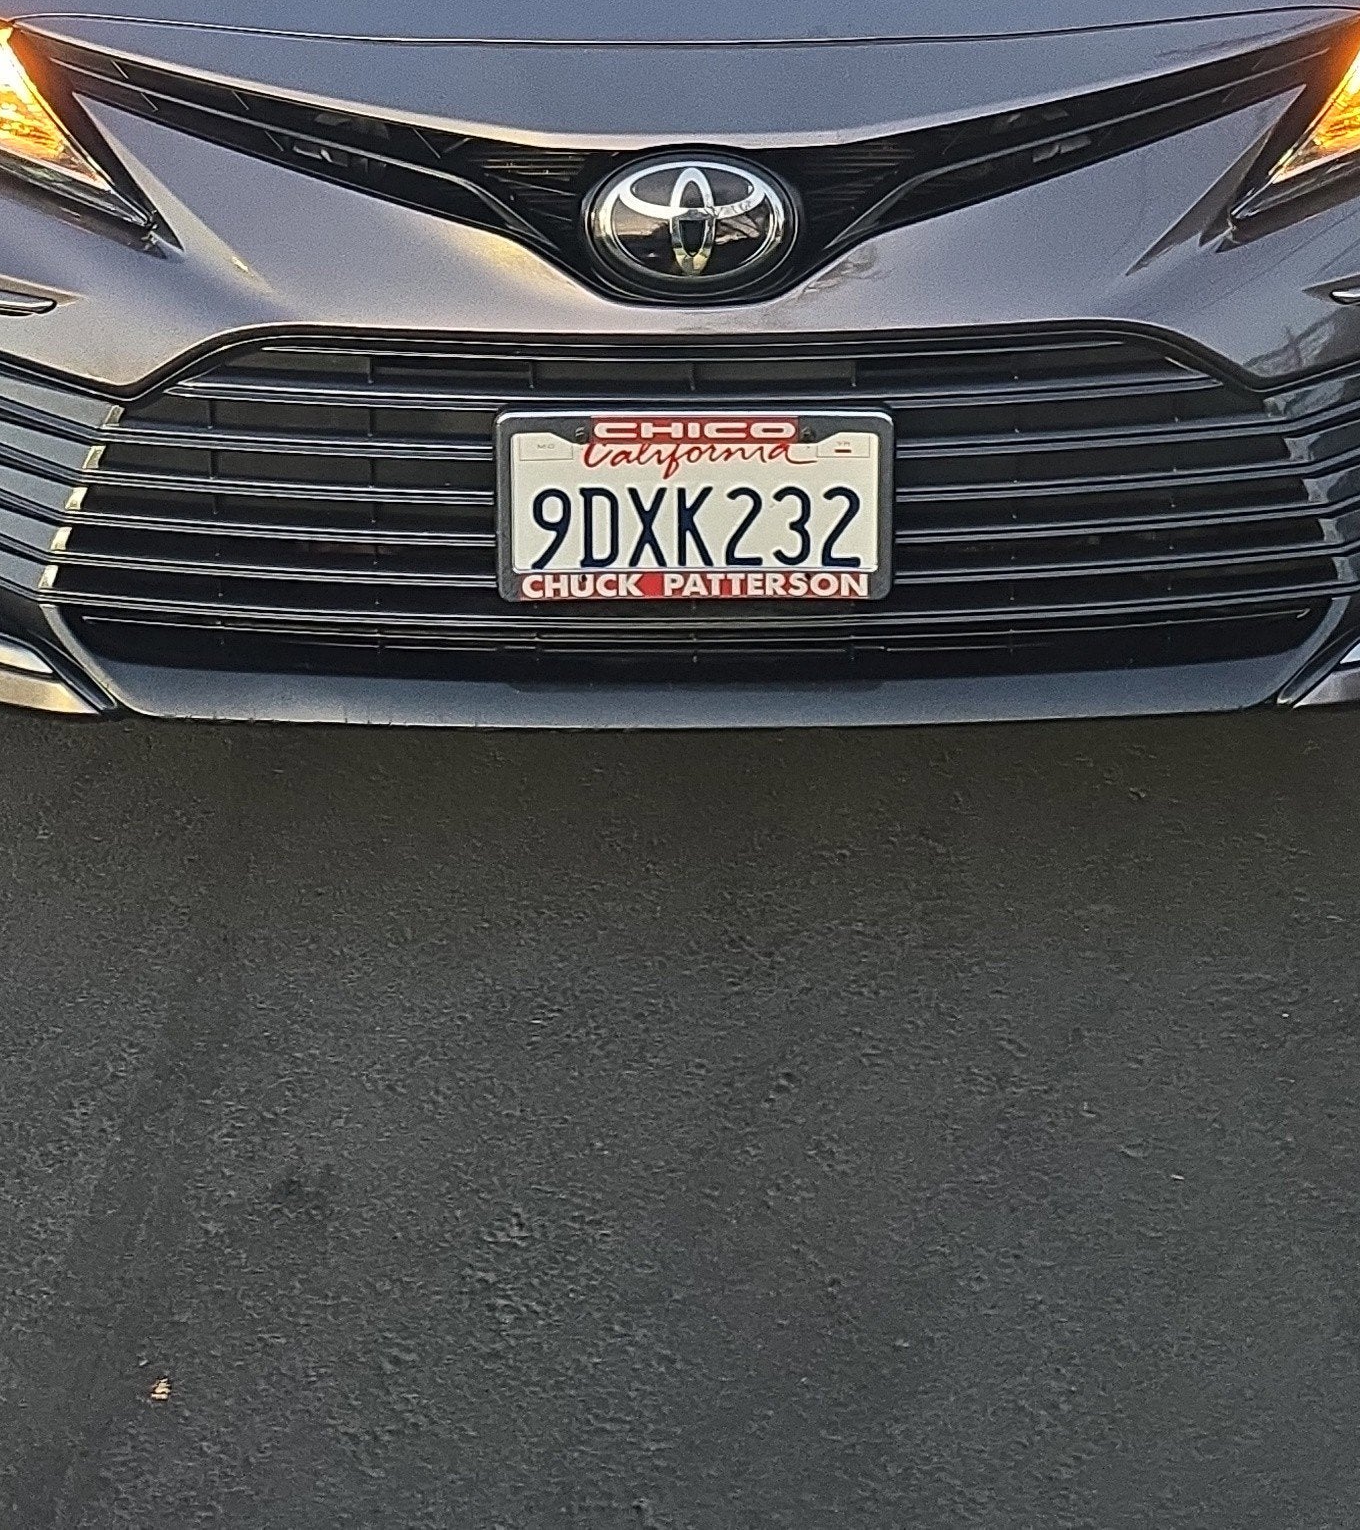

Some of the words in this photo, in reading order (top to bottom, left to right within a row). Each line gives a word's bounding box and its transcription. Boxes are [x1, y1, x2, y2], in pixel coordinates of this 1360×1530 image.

[593, 421, 796, 440] CHICO
[583, 442, 818, 479] California
[530, 485, 862, 569] 9DXK232
[521, 573, 646, 599] CHUCK
[663, 573, 869, 598] PATTERSON
